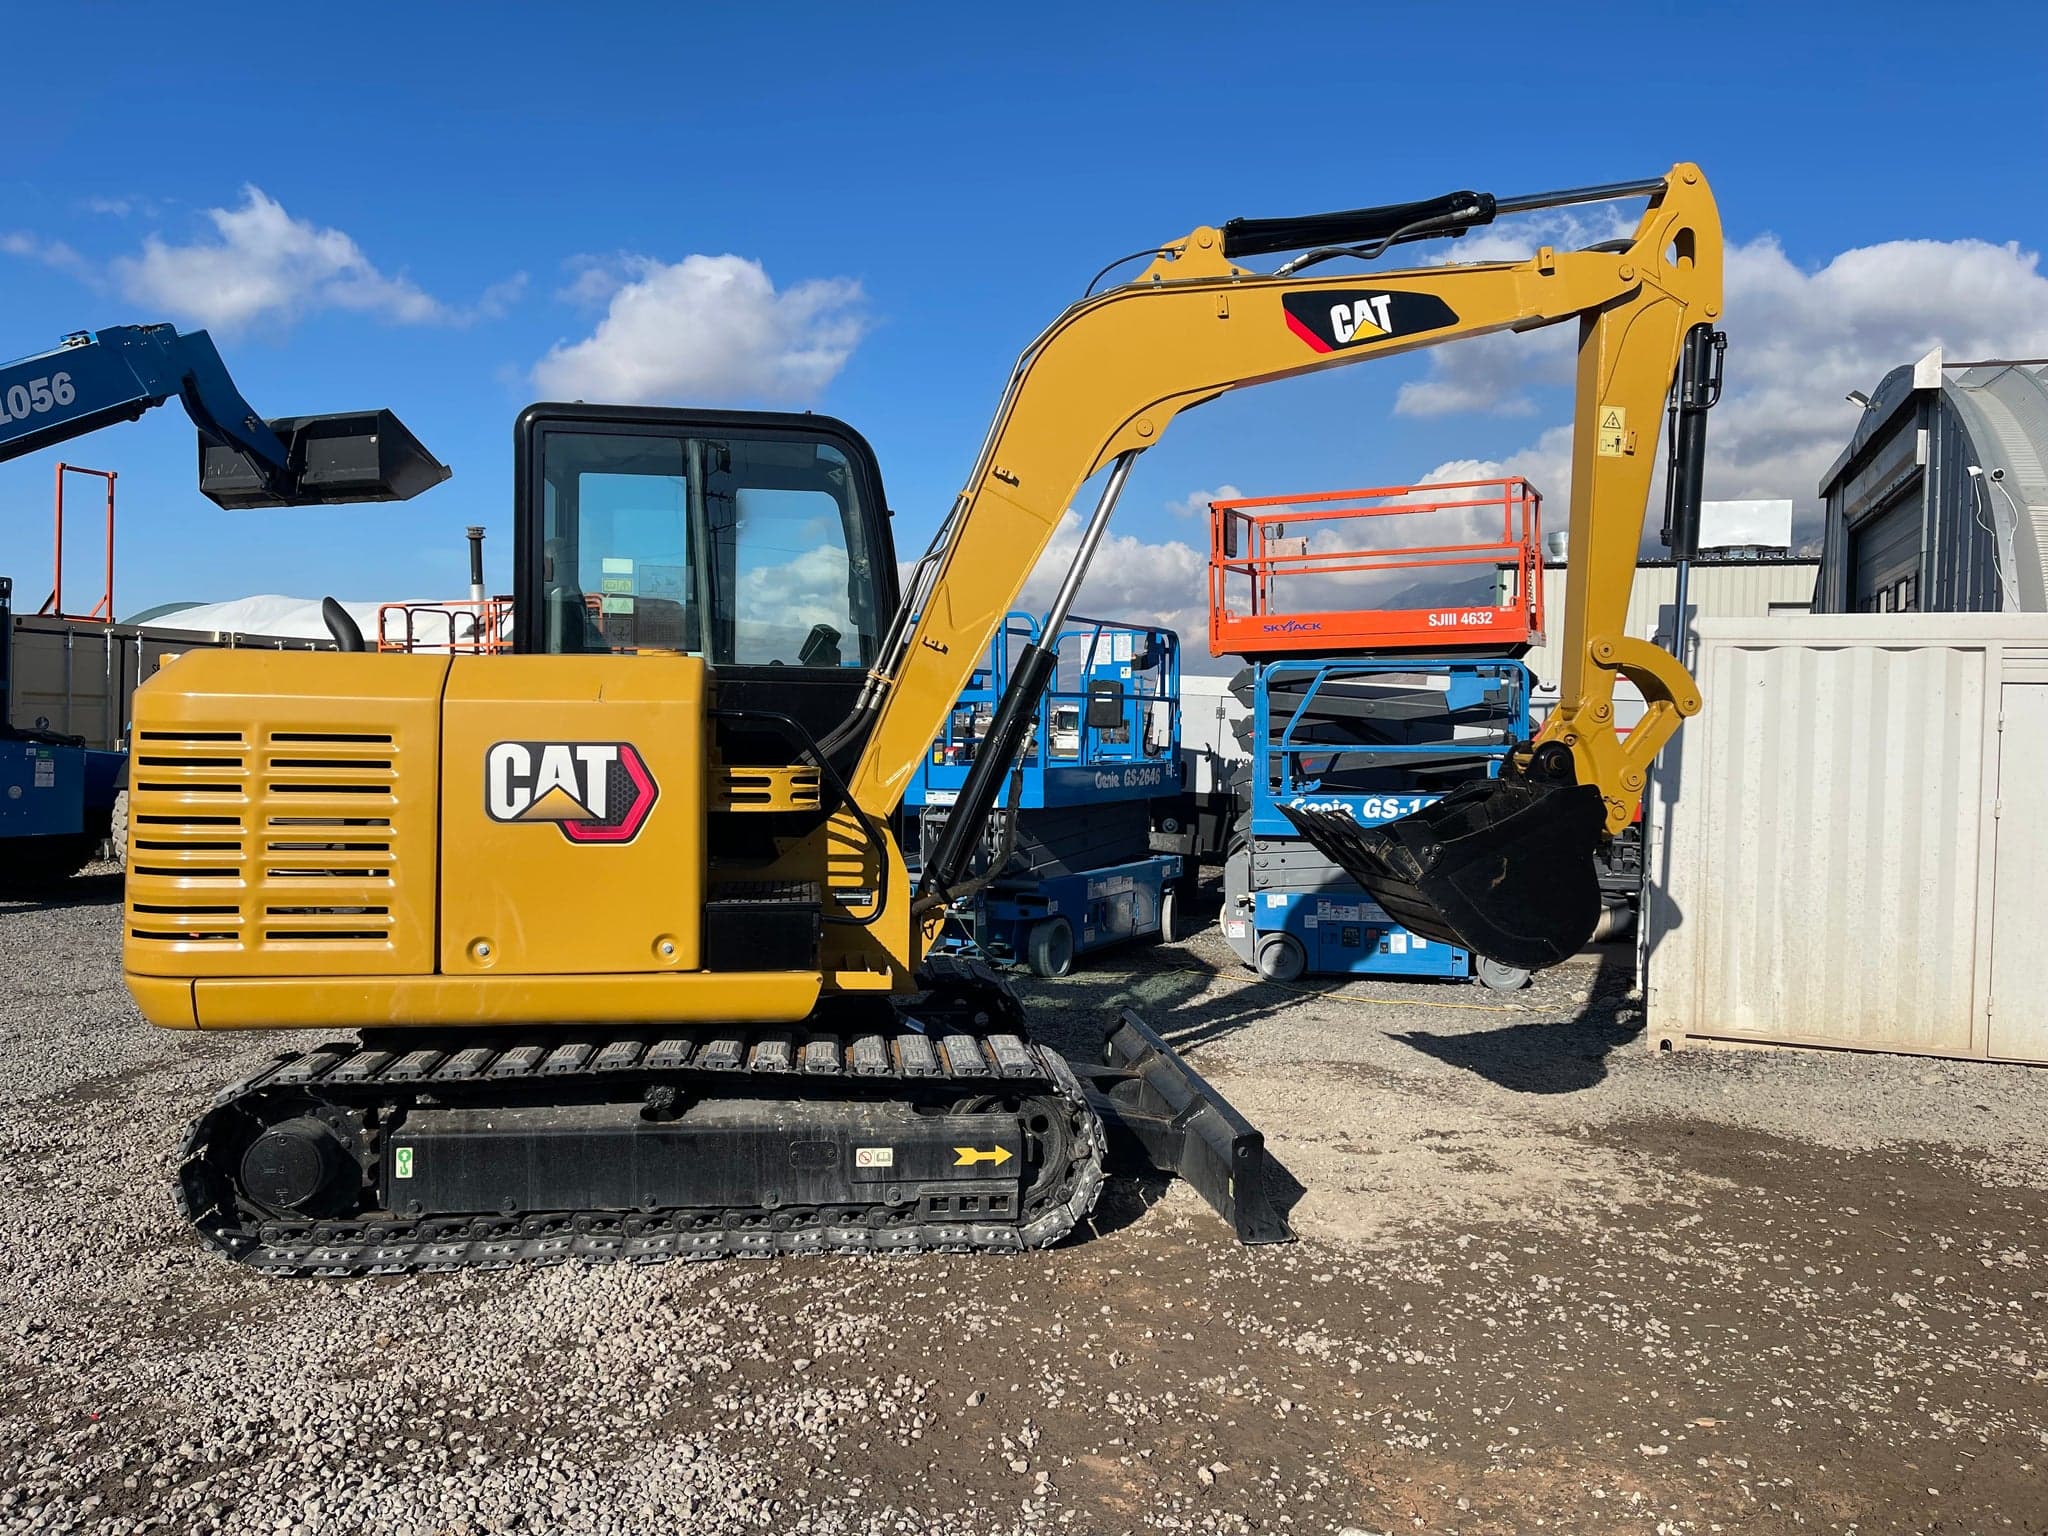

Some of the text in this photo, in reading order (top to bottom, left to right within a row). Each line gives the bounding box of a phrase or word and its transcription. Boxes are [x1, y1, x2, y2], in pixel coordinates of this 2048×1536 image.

[1330, 294, 1393, 343] CAT
[1264, 620, 1321, 633] SKYJACK
[1428, 611, 1493, 627] SJIII 4632
[490, 743, 617, 819] CAT
[1095, 767, 1161, 789] Genie GS-2646
